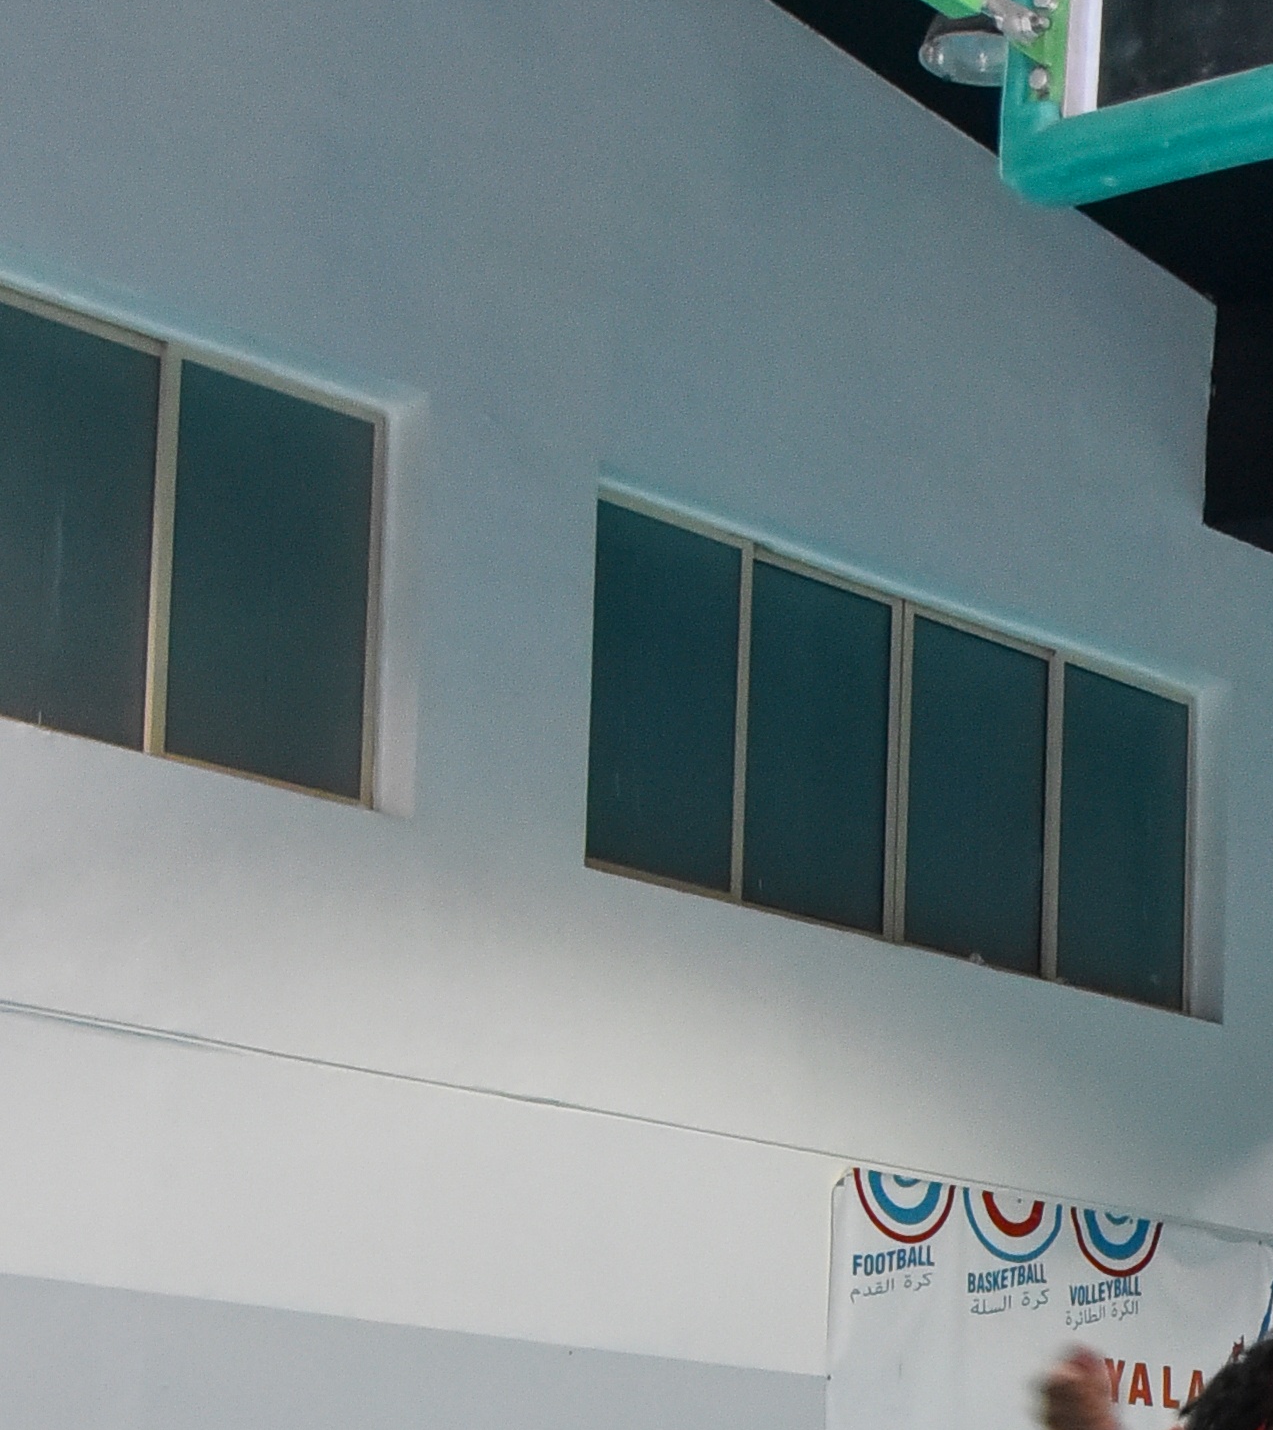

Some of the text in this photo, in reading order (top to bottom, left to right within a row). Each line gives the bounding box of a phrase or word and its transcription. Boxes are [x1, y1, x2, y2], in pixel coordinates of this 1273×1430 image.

[852, 1244, 935, 1277] FOOTBALL
[849, 1273, 933, 1304] كرة القدم
[967, 1263, 1048, 1294] BASKETBALL
[1069, 1276, 1142, 1307] VOLLEYBALL
[970, 1288, 1050, 1316] كرة السلة
[1065, 1301, 1140, 1330] الكرة الطائرة
